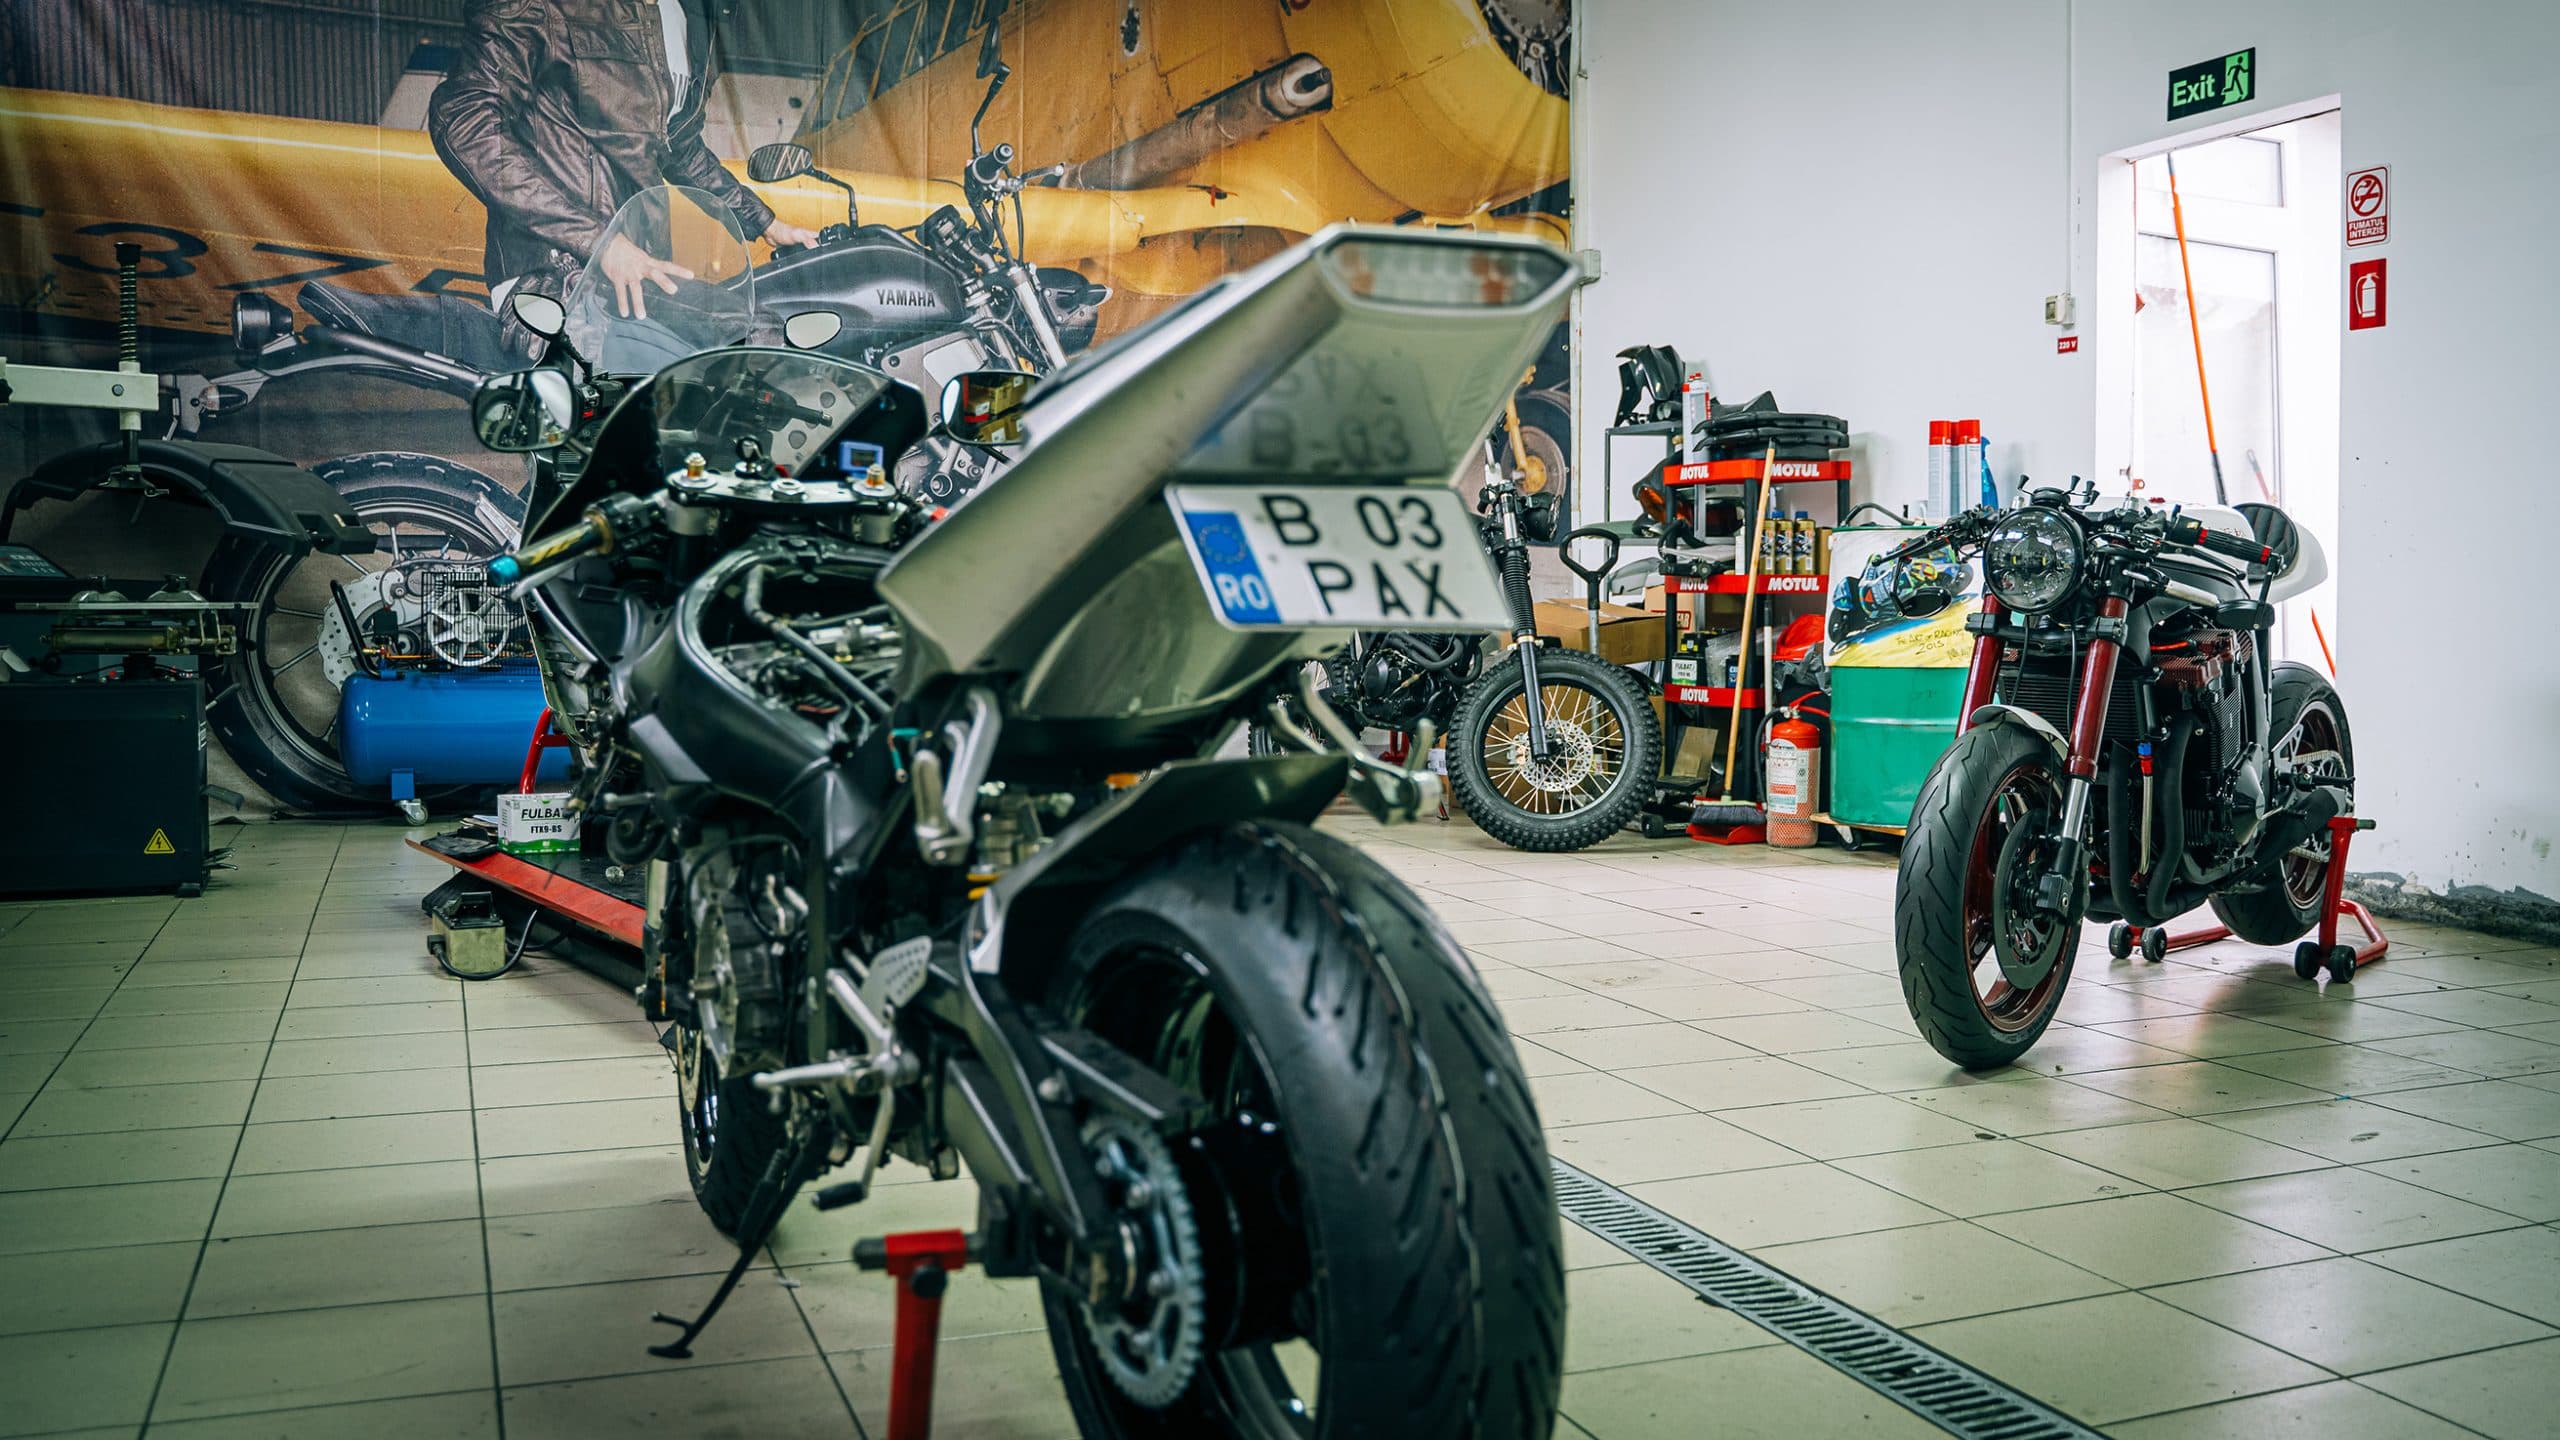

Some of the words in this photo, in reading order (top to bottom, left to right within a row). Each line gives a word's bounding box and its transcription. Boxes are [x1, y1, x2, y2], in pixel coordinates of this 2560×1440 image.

[2172, 74, 2216, 107] Exit
[2349, 217, 2385, 231] FUMATUL
[2349, 226, 2385, 239] INTERZIS
[876, 288, 936, 308] YAMAHA
[1680, 465, 1709, 480] MOTUL
[1770, 463, 1820, 477] MOTUL
[1258, 494, 1322, 547] B
[1356, 496, 1443, 549] 03
[1307, 560, 1463, 618] PAX
[1680, 577, 1709, 591] MOTUL
[1768, 577, 1820, 591] MOTUL
[1215, 573, 1269, 611] RO
[1915, 641, 1945, 655] 2015
[1680, 688, 1709, 703] MOTUL
